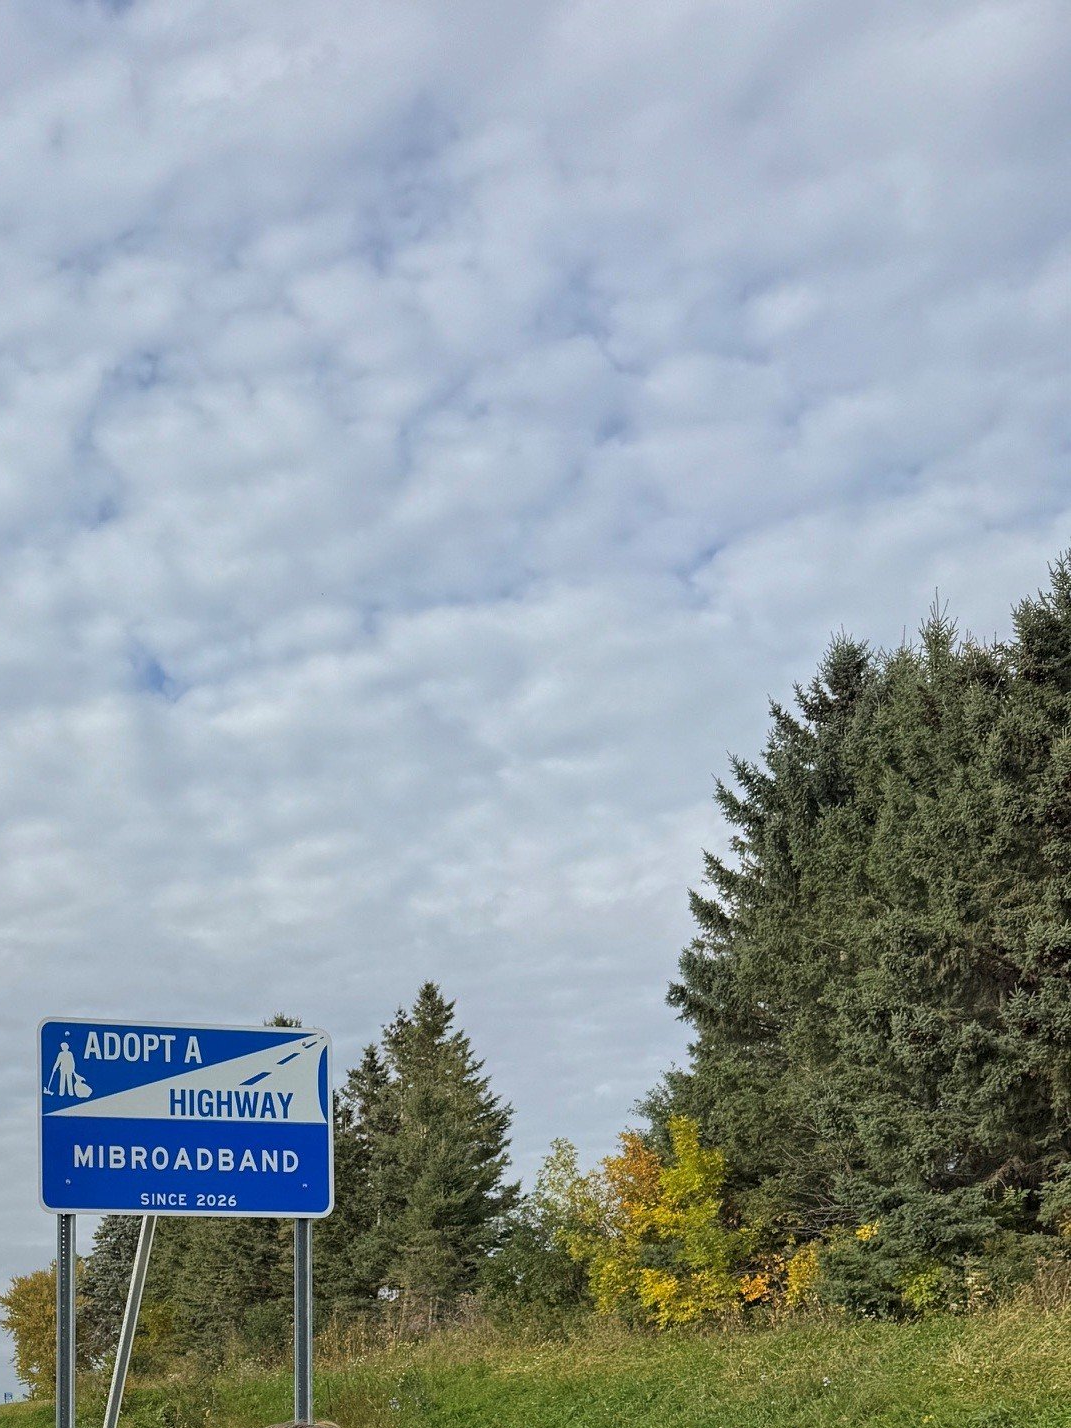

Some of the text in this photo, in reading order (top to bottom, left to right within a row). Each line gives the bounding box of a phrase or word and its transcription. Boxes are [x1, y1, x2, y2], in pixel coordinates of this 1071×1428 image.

[83, 1031, 203, 1064] ADOPT A
[169, 1088, 294, 1119] HIGHWAY
[73, 1144, 299, 1173] MIBROADBAND
[140, 1193, 237, 1208] SINCE 2026
